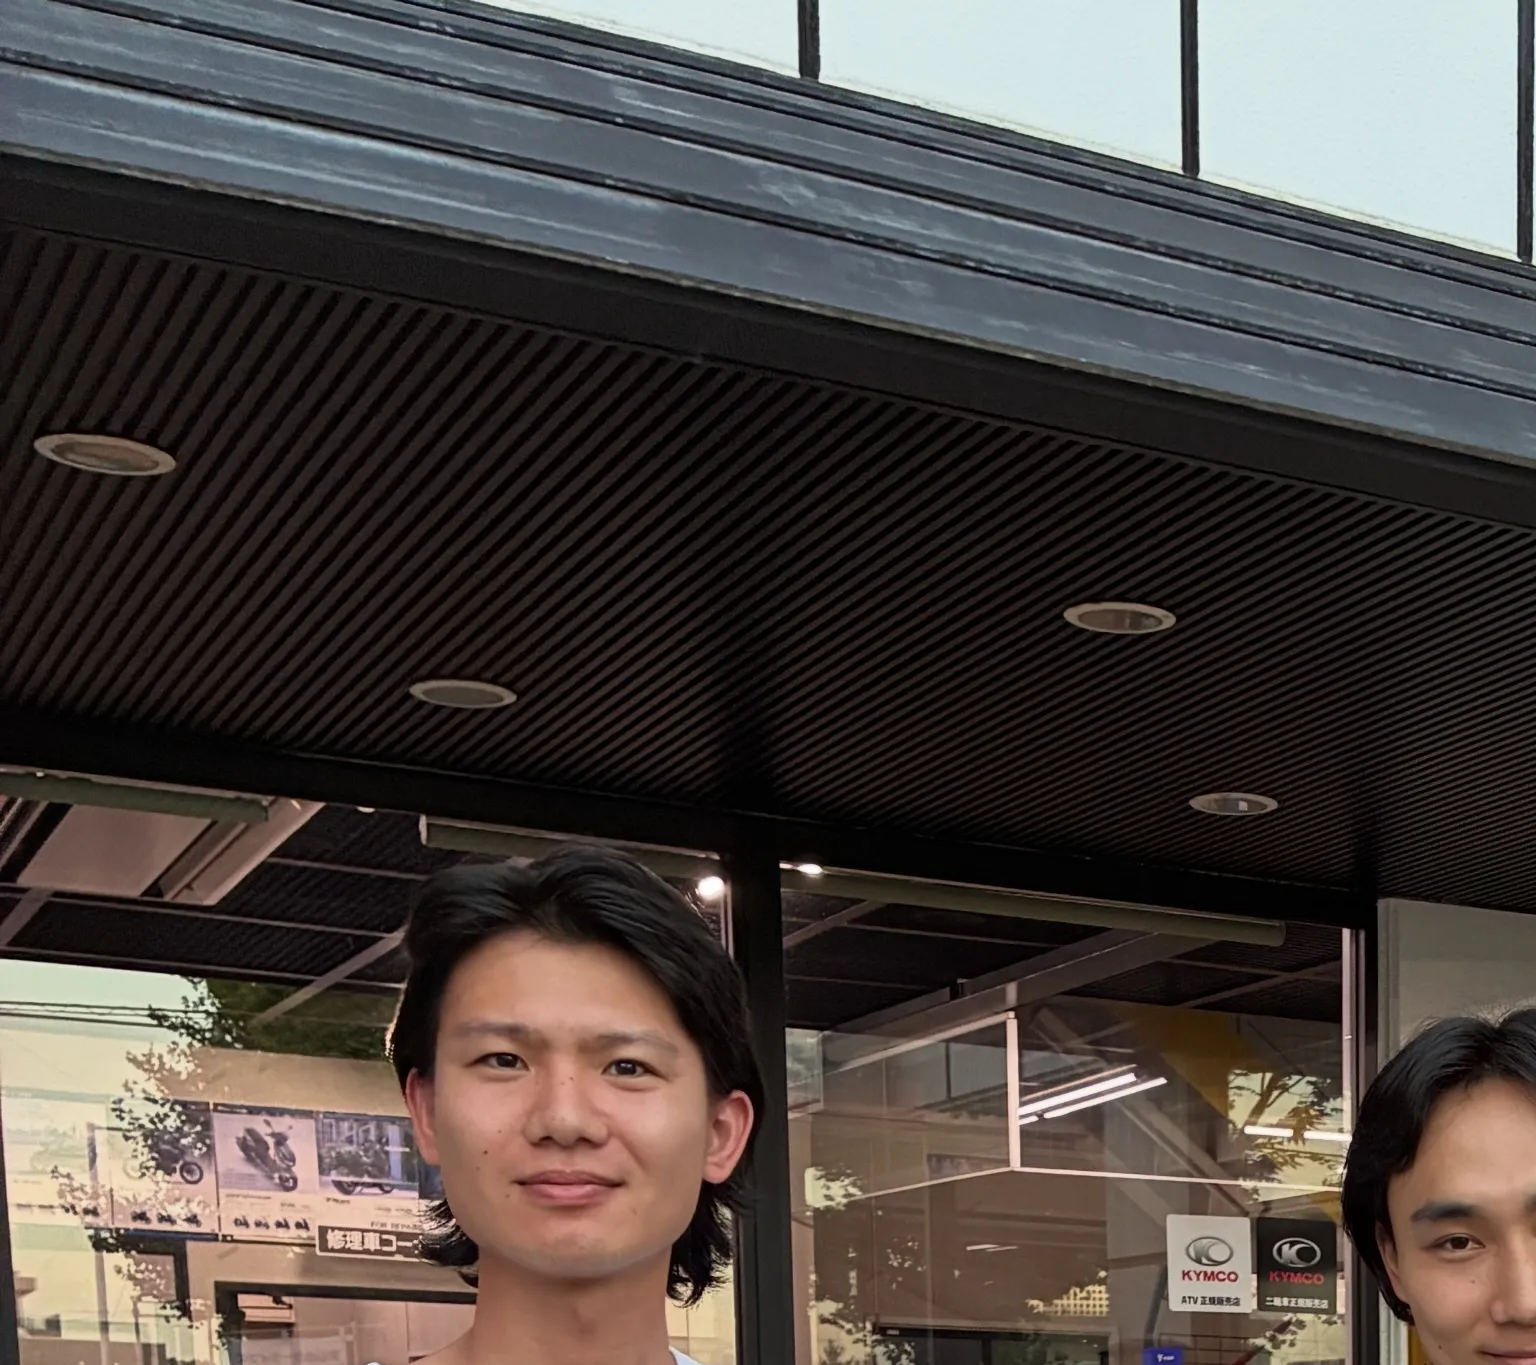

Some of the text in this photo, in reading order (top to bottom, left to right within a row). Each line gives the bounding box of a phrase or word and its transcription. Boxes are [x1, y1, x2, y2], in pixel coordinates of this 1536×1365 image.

[1181, 1269, 1239, 1283] KYMCO
[1269, 1270, 1325, 1285] KYMCO
[1181, 1296, 1198, 1305] ATV
